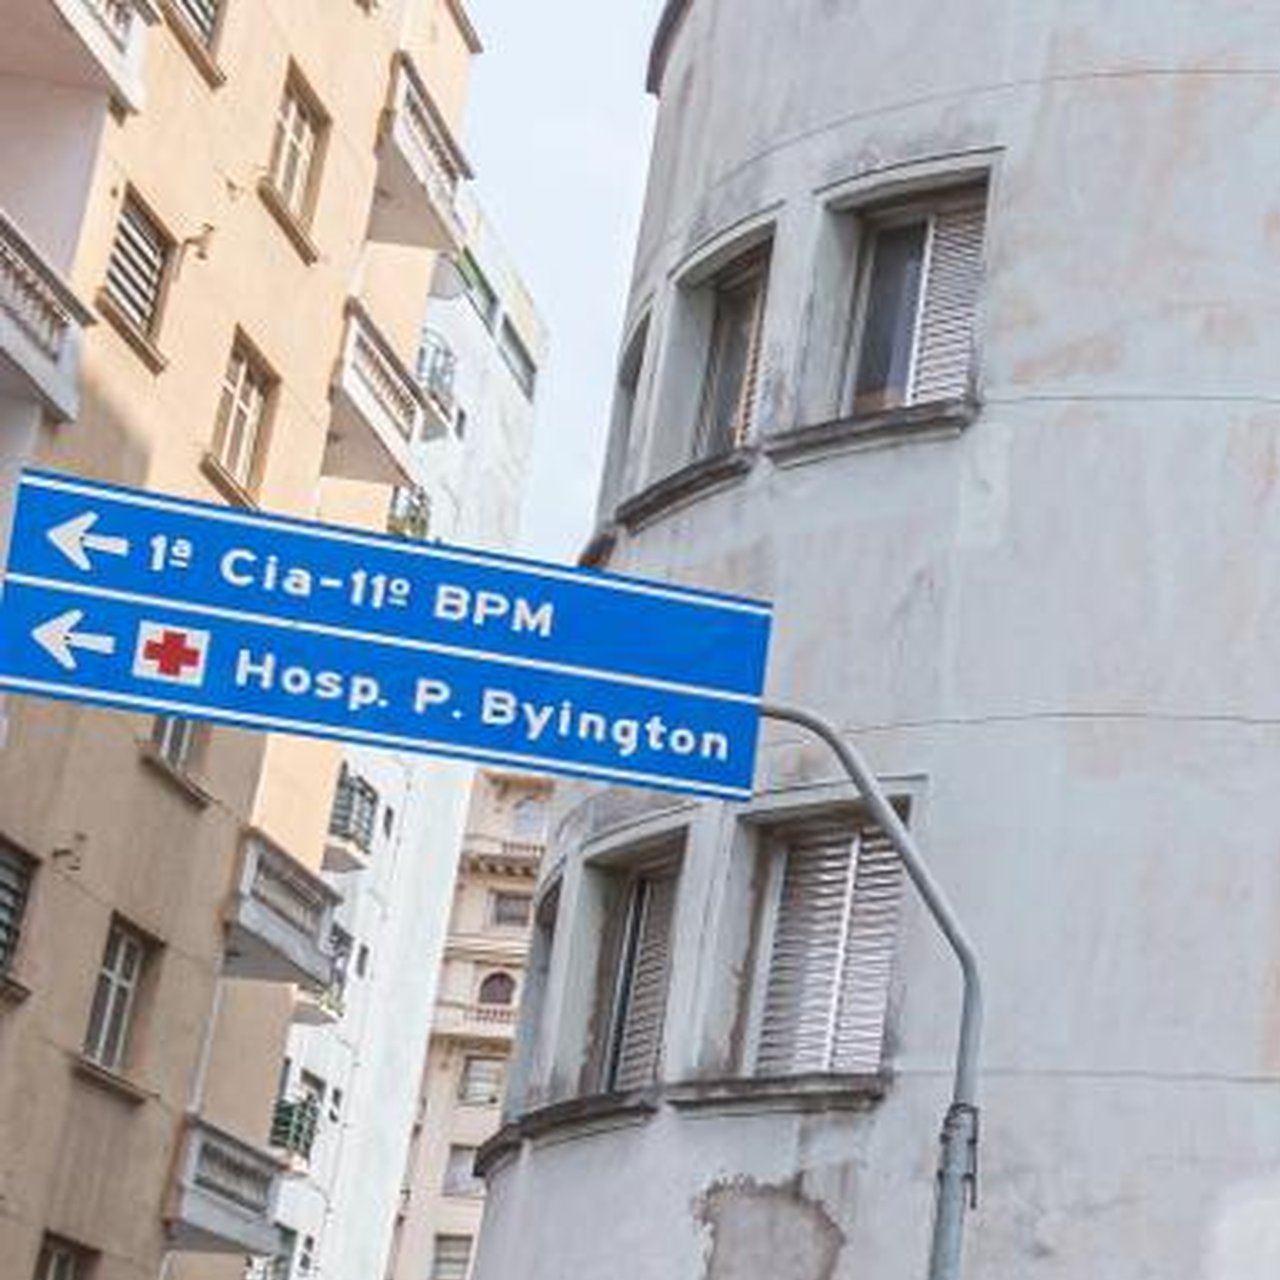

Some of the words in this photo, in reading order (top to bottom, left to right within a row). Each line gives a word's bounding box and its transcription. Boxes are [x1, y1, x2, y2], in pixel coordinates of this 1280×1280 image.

[149, 534, 194, 573] 1ª
[433, 584, 556, 638] BPM
[235, 649, 389, 712] Hosp.
[414, 678, 463, 720] P.
[480, 688, 729, 762] Byington
